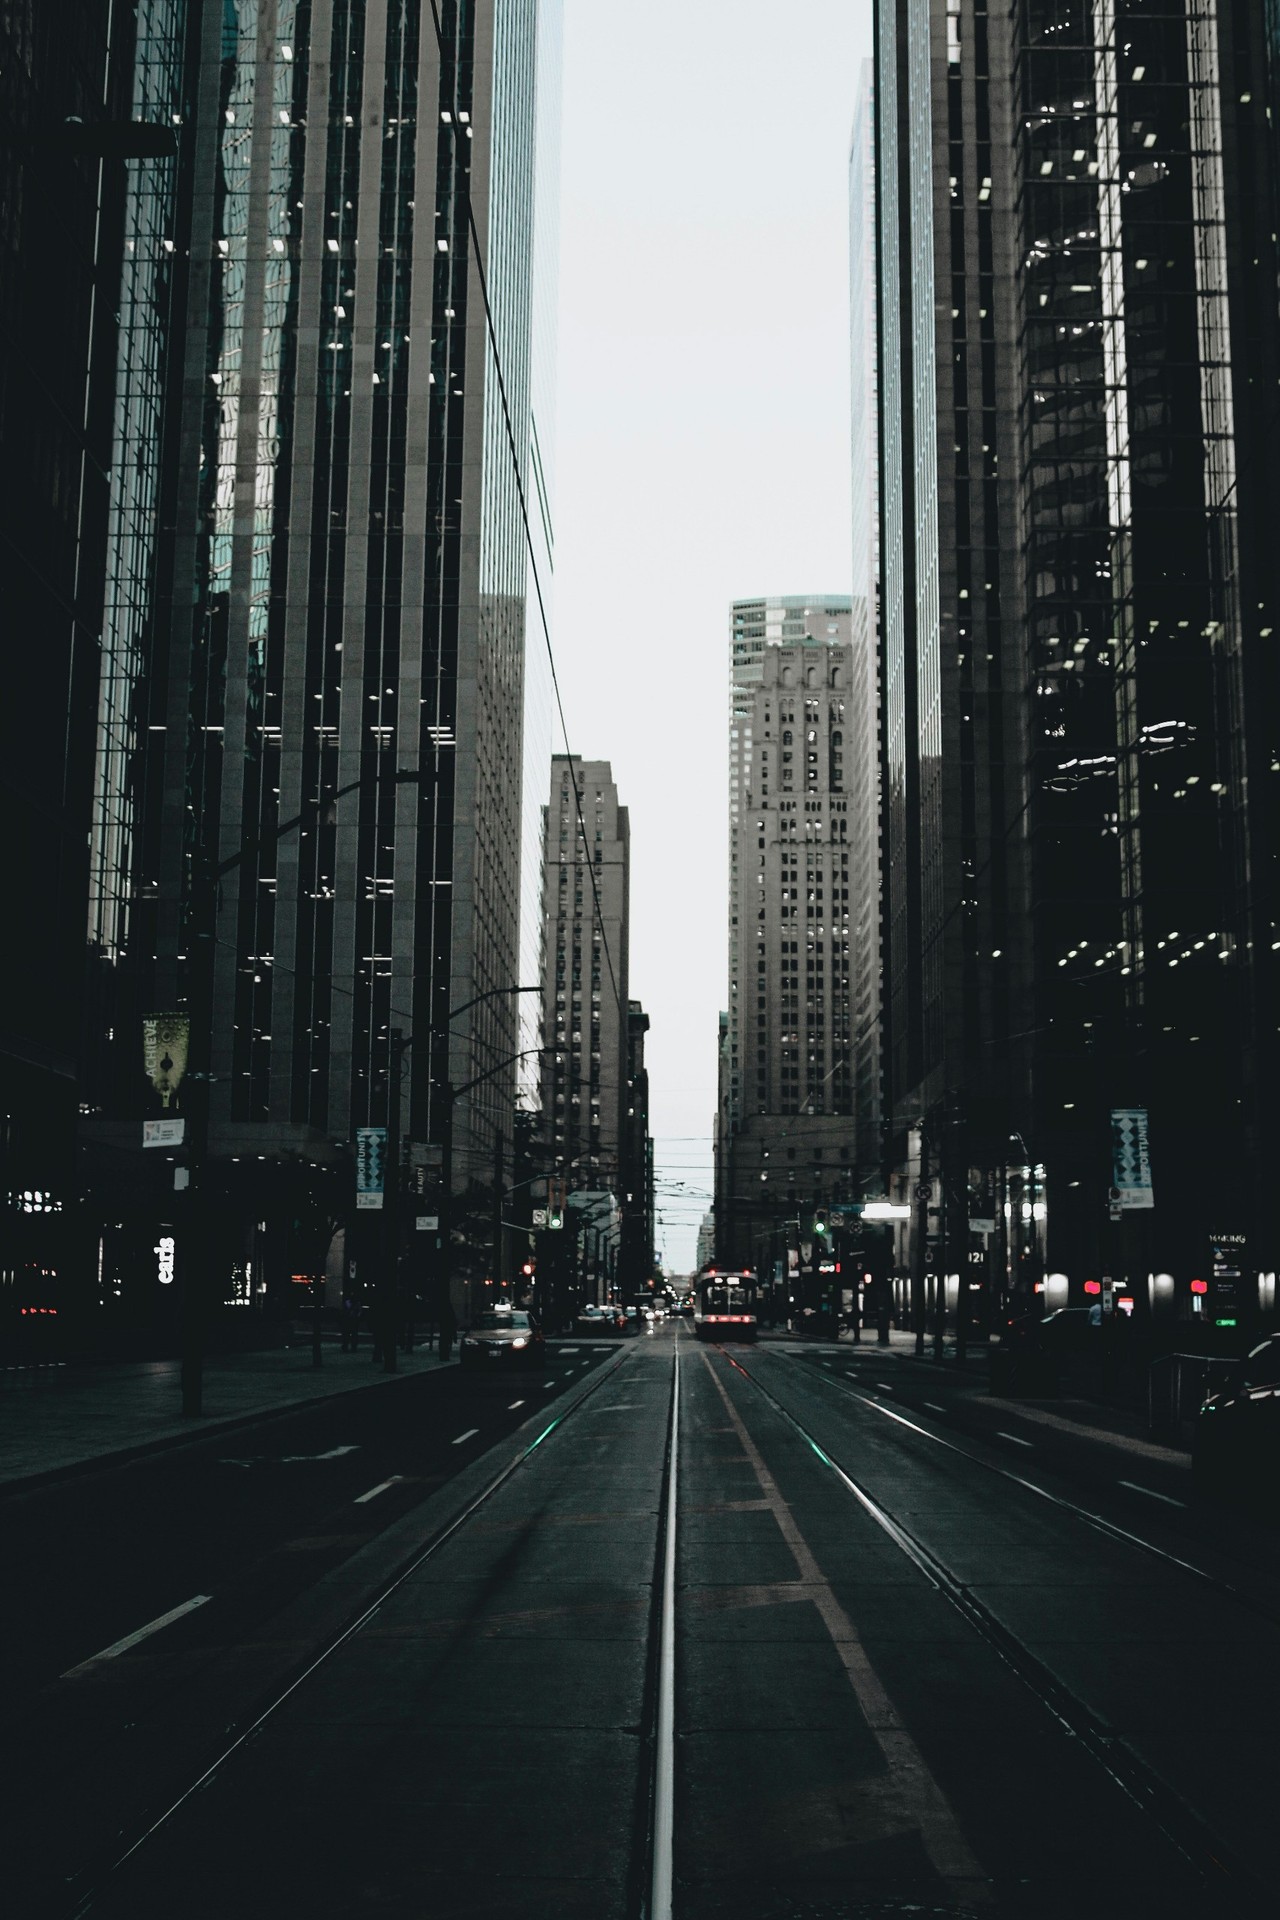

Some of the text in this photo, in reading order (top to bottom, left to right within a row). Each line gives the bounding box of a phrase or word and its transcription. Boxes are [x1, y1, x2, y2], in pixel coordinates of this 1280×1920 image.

[145, 1019, 157, 1078] ACHIEVE
[357, 1131, 366, 1190] OPPORTUNITY
[1138, 1115, 1151, 1184] OPPORTUNITY
[416, 1166, 424, 1194] BEAUTY
[968, 1251, 984, 1263] 121
